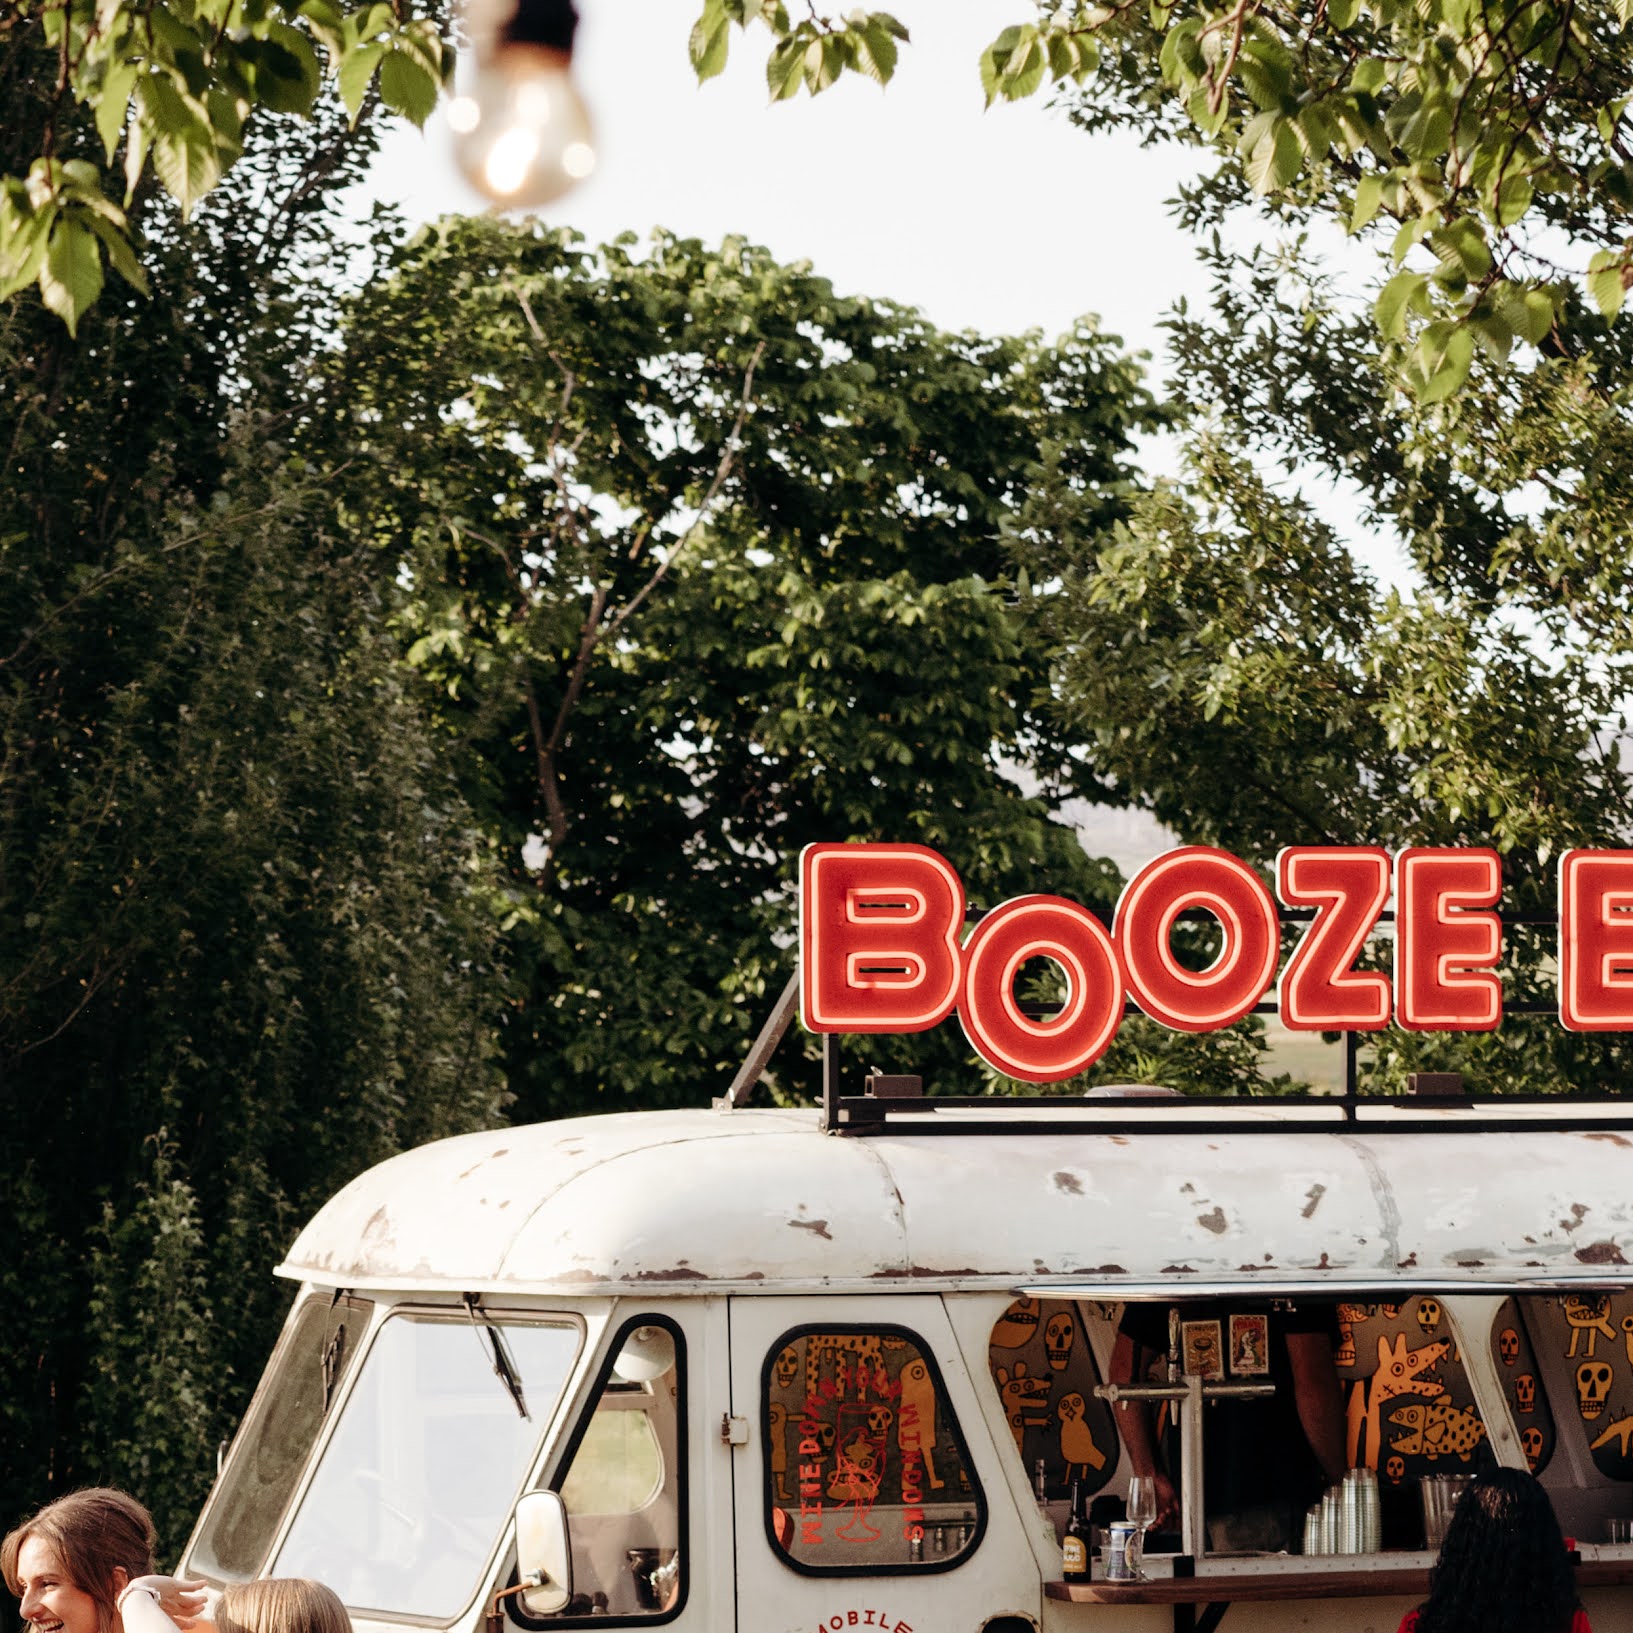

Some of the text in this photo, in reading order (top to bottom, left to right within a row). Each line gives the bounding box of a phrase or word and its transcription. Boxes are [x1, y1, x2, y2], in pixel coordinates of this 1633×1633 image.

[800, 841, 1503, 1083] BOOZE
[799, 1365, 925, 1545] WINE DOWN YOUR WINDOWS
